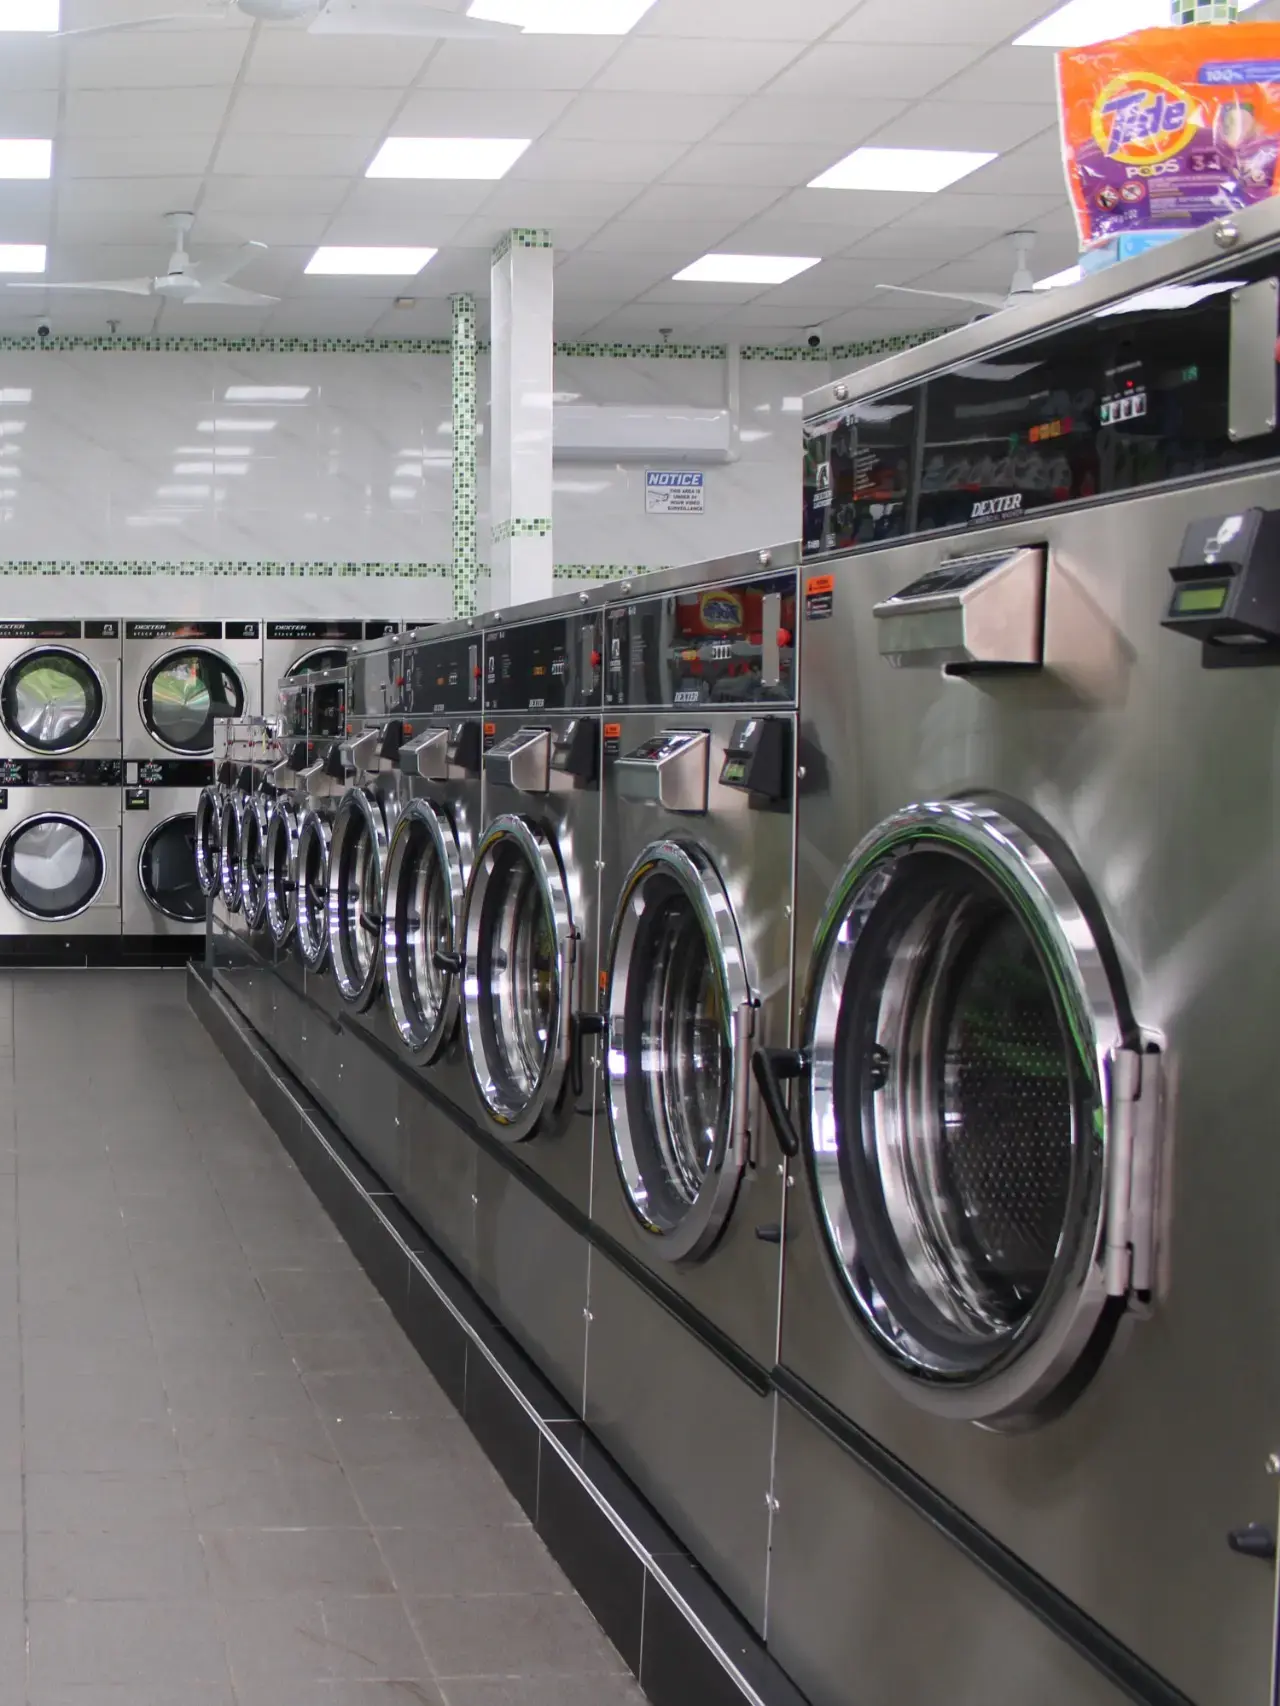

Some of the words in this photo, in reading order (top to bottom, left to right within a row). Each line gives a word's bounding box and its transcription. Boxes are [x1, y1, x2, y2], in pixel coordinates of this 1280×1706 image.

[1102, 91, 1186, 155] Tide
[1125, 158, 1180, 179] PODS
[648, 474, 701, 485] NOTICE
[970, 493, 1022, 518] DEXTER
[674, 691, 700, 702] DEXTER
